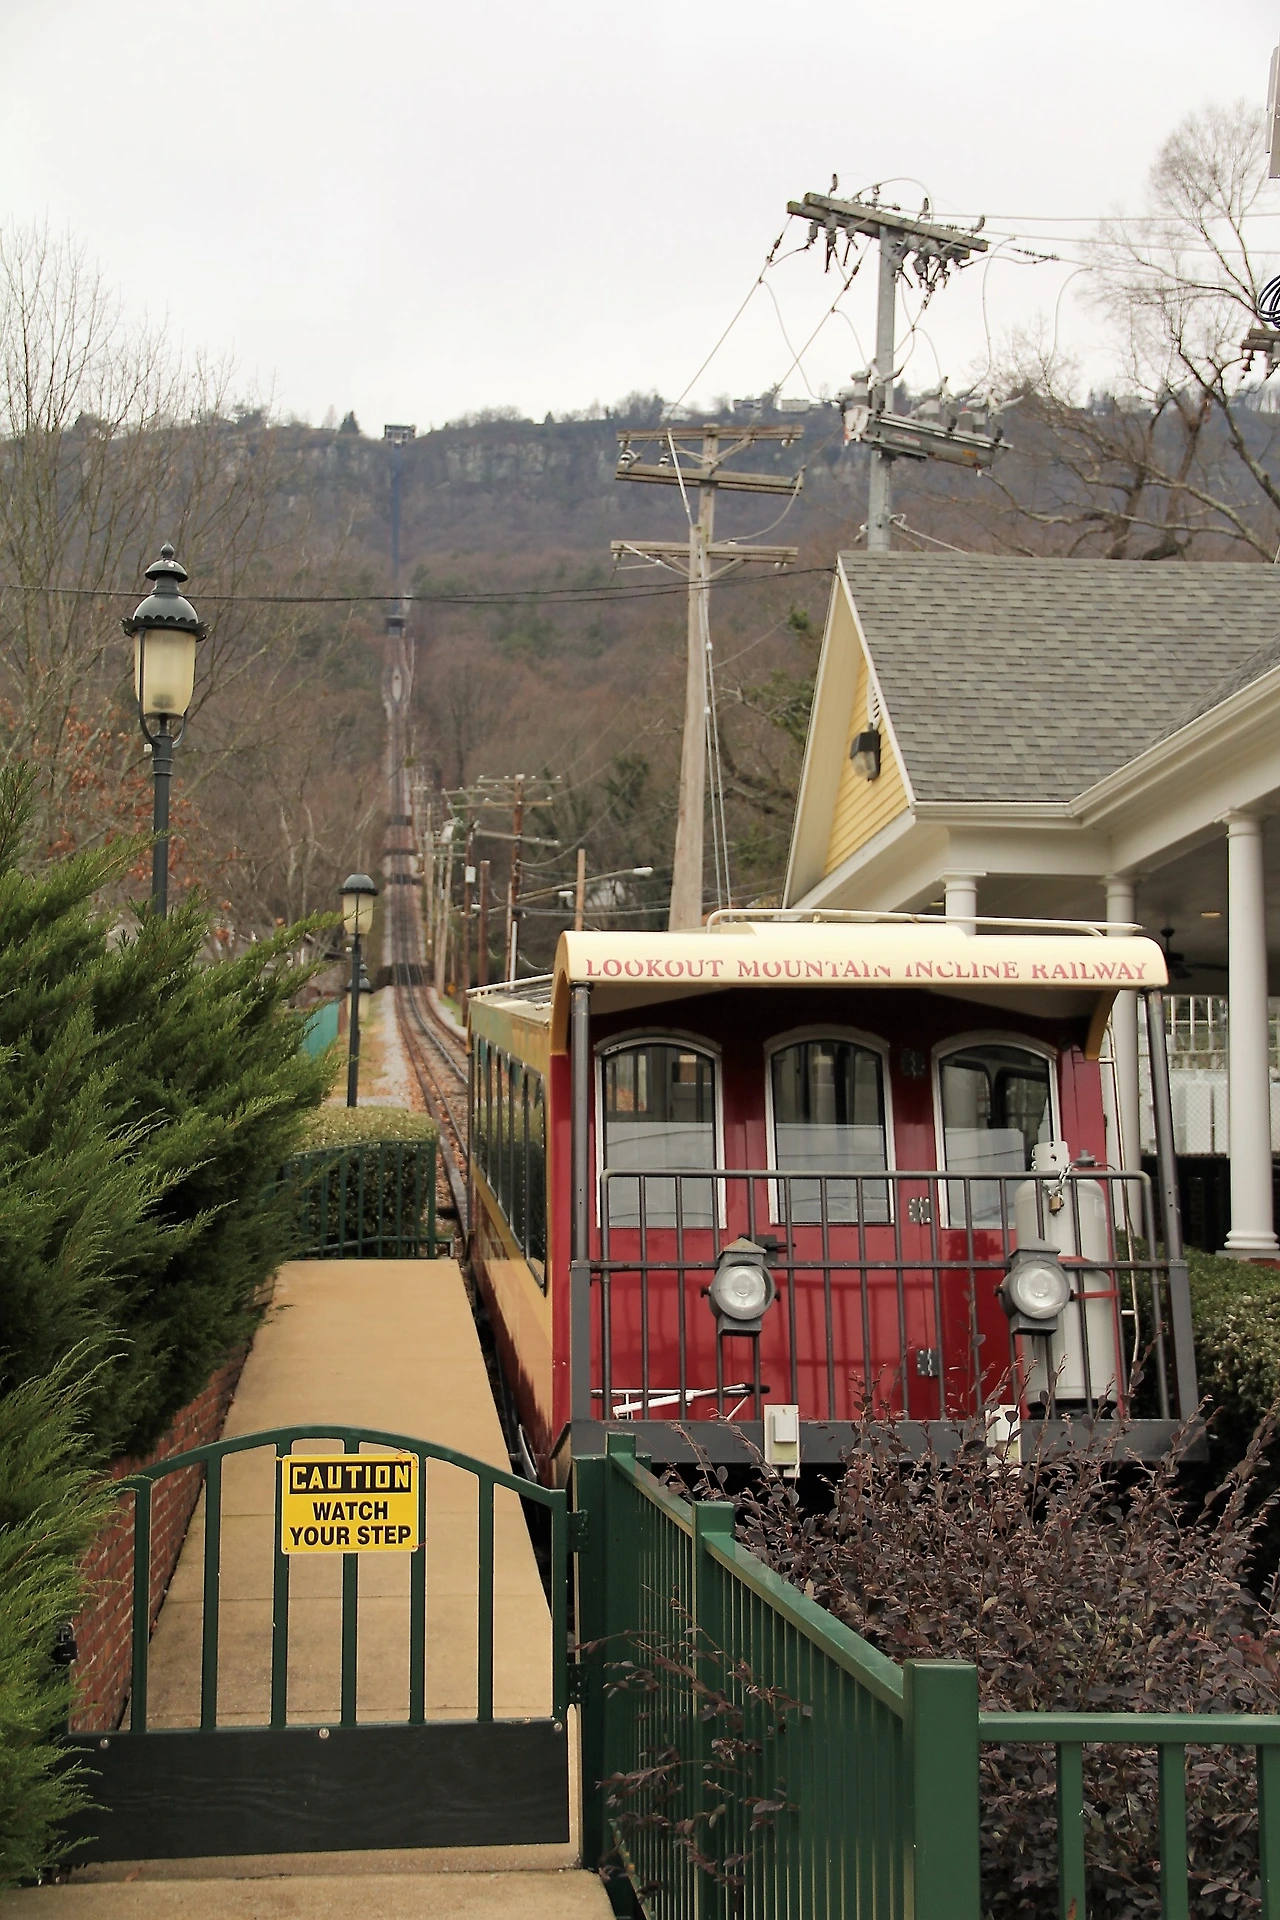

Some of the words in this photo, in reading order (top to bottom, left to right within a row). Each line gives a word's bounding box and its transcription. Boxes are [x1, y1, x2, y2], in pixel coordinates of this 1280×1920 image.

[586, 959, 724, 977] LOOKOUT
[737, 960, 891, 978] MOUNTAIN
[905, 960, 1020, 979] INCLINE
[1031, 961, 1148, 980] RAILWAY
[292, 1465, 409, 1490] CAUTION
[312, 1501, 389, 1521] WATCH
[289, 1526, 350, 1546] YOUR
[356, 1525, 412, 1545] STEP
